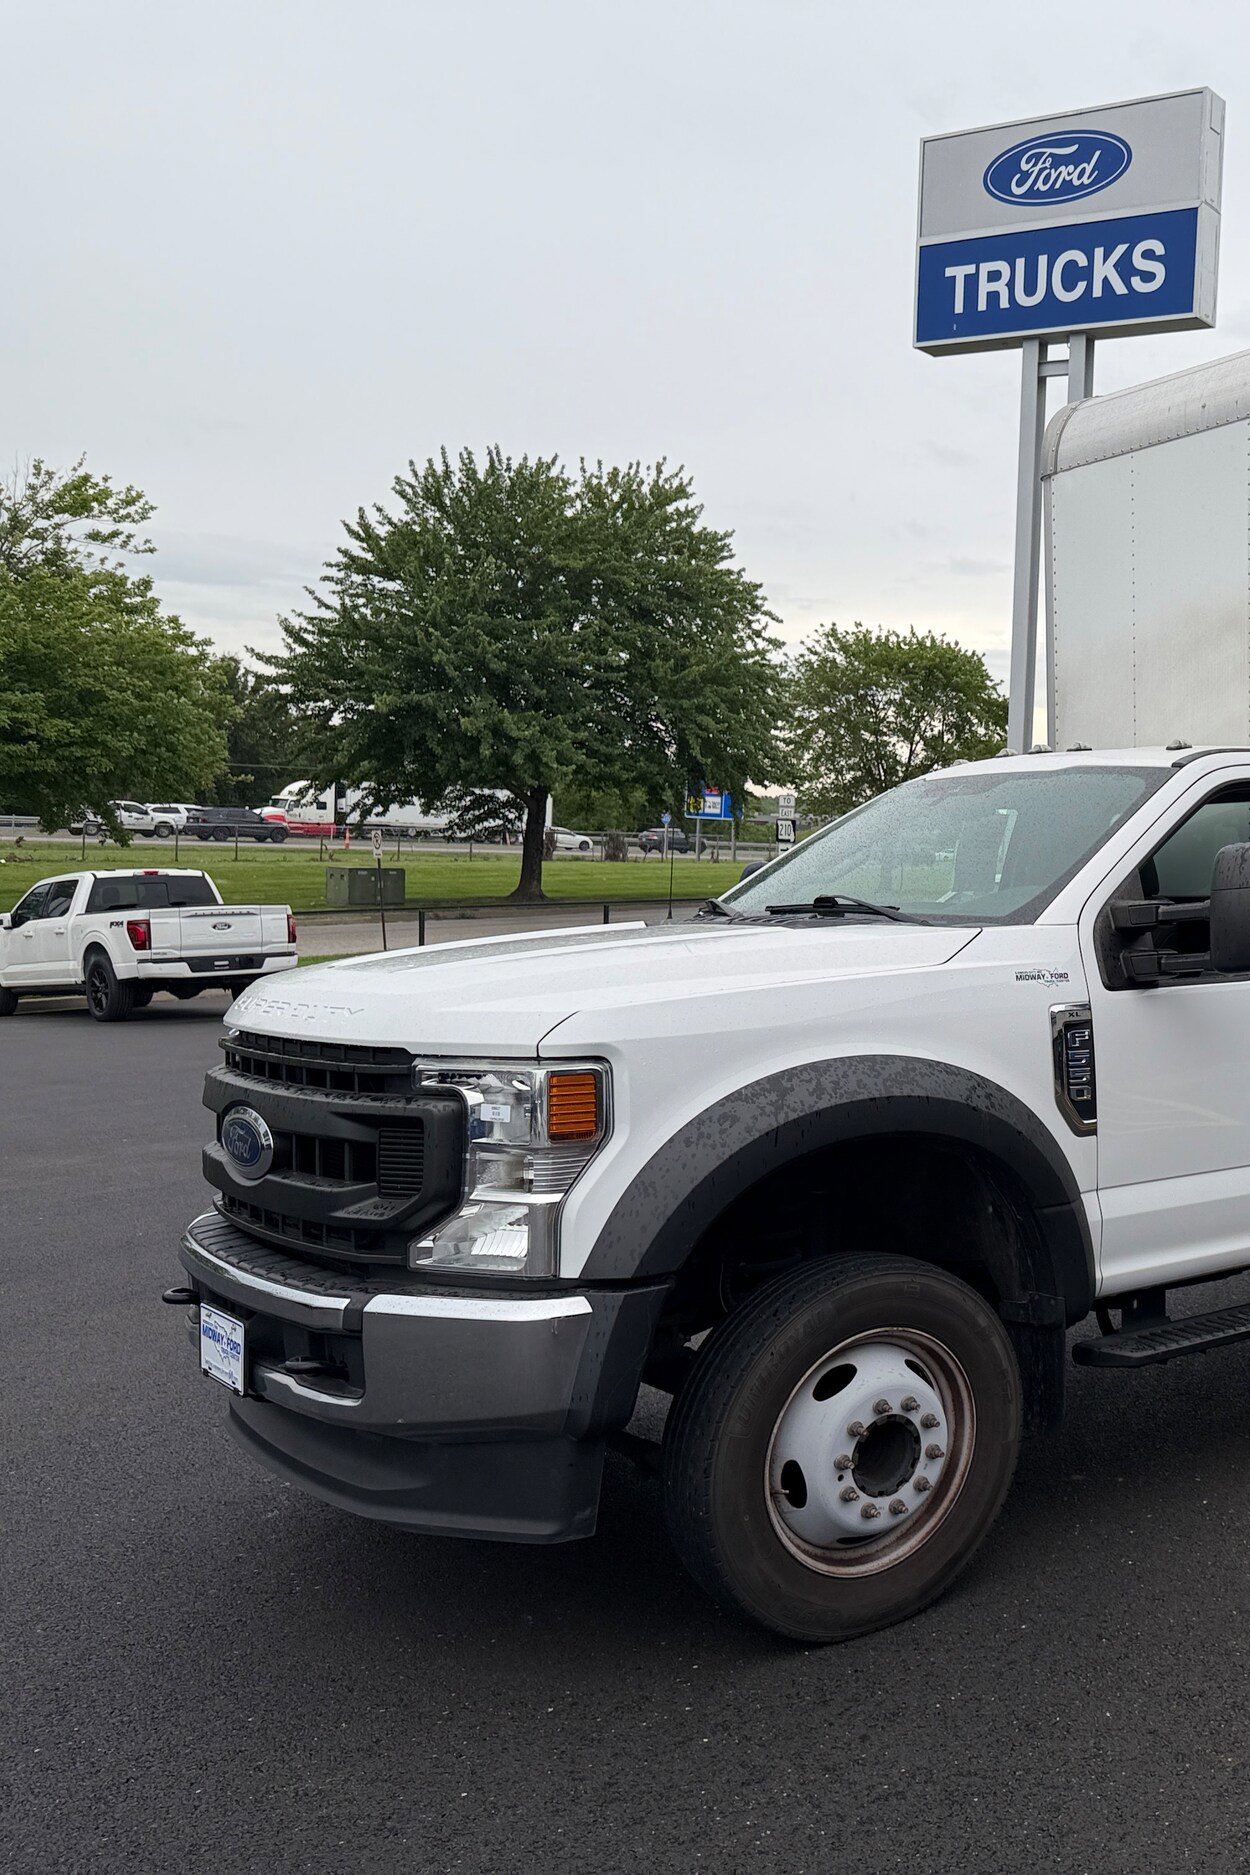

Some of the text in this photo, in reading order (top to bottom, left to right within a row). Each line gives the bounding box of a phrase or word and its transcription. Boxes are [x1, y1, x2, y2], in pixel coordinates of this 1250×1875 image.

[1010, 143, 1102, 196] Ford
[944, 238, 1167, 315] TRUCKS
[782, 797, 792, 805] TO
[780, 809, 793, 817] EAST
[779, 824, 792, 837] 210
[1015, 973, 1046, 982] MIDWAY
[1050, 972, 1069, 980] FORD
[227, 1123, 252, 1160] Ford
[202, 1324, 225, 1346] MIDWAY
[227, 1337, 241, 1356] FORD
